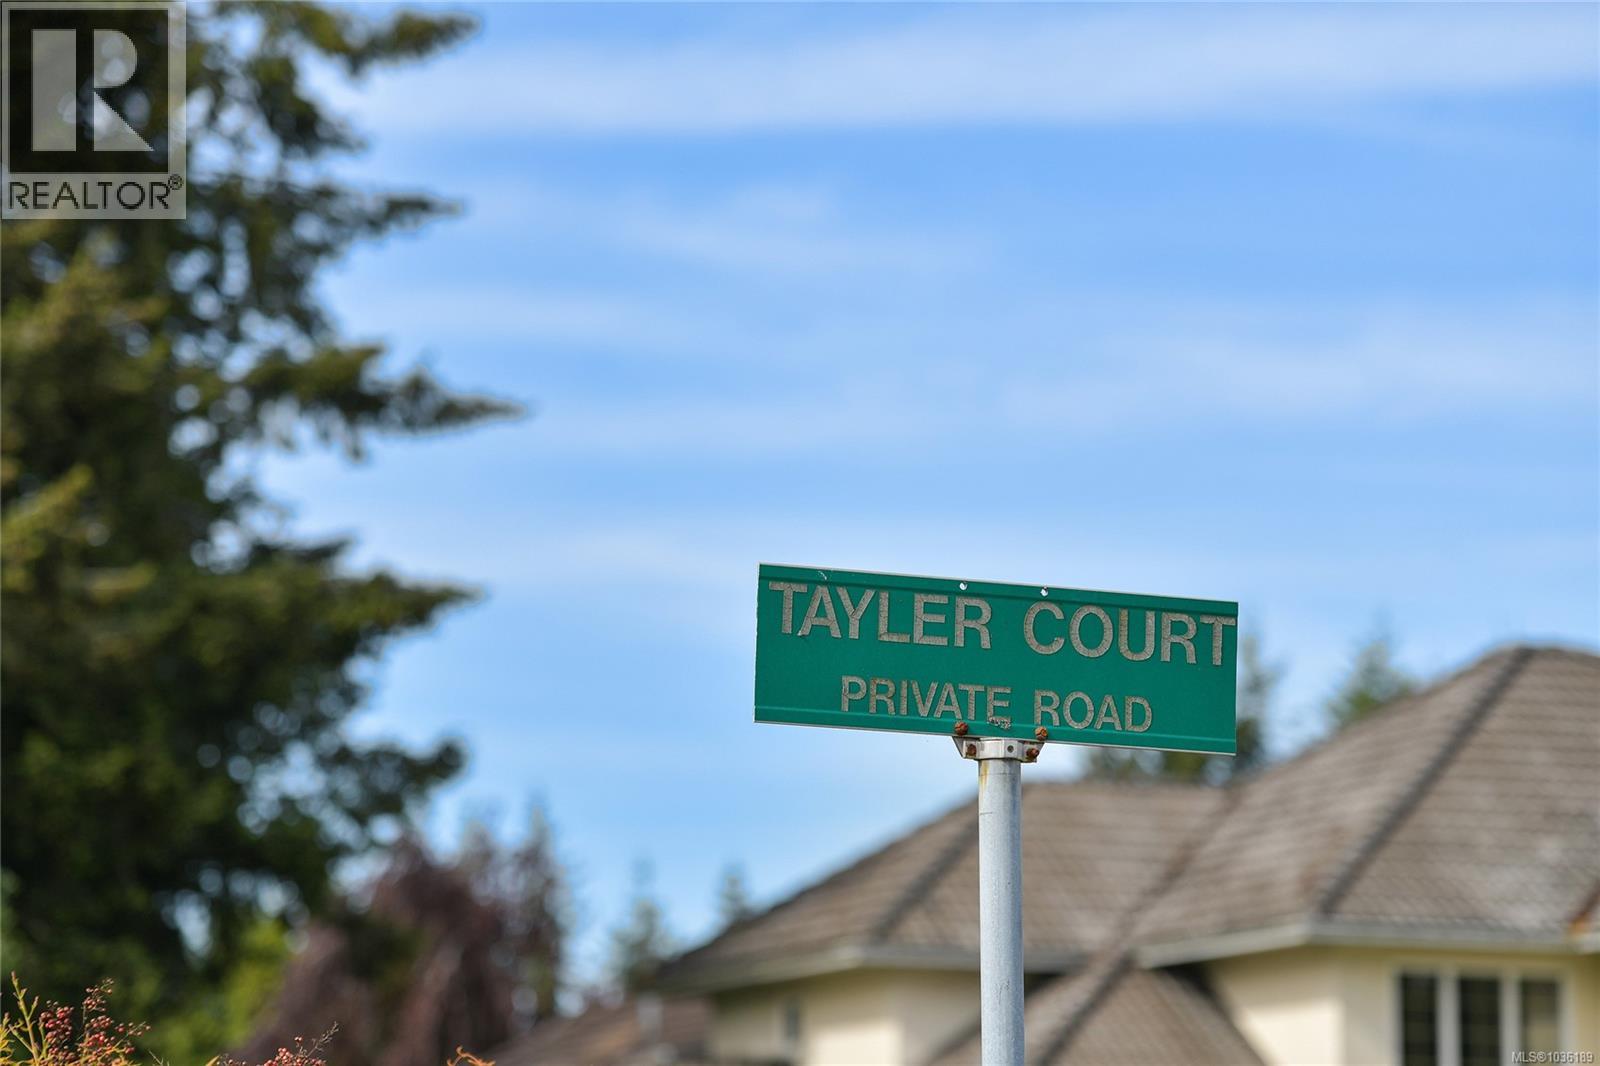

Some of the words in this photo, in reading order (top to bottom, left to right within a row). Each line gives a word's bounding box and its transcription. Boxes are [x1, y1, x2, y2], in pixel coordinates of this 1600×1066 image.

[768, 581, 992, 650] TAYLER
[1023, 600, 1236, 667] COURT
[840, 675, 1011, 725] PRIVATE
[1034, 689, 1153, 733] ROAD
